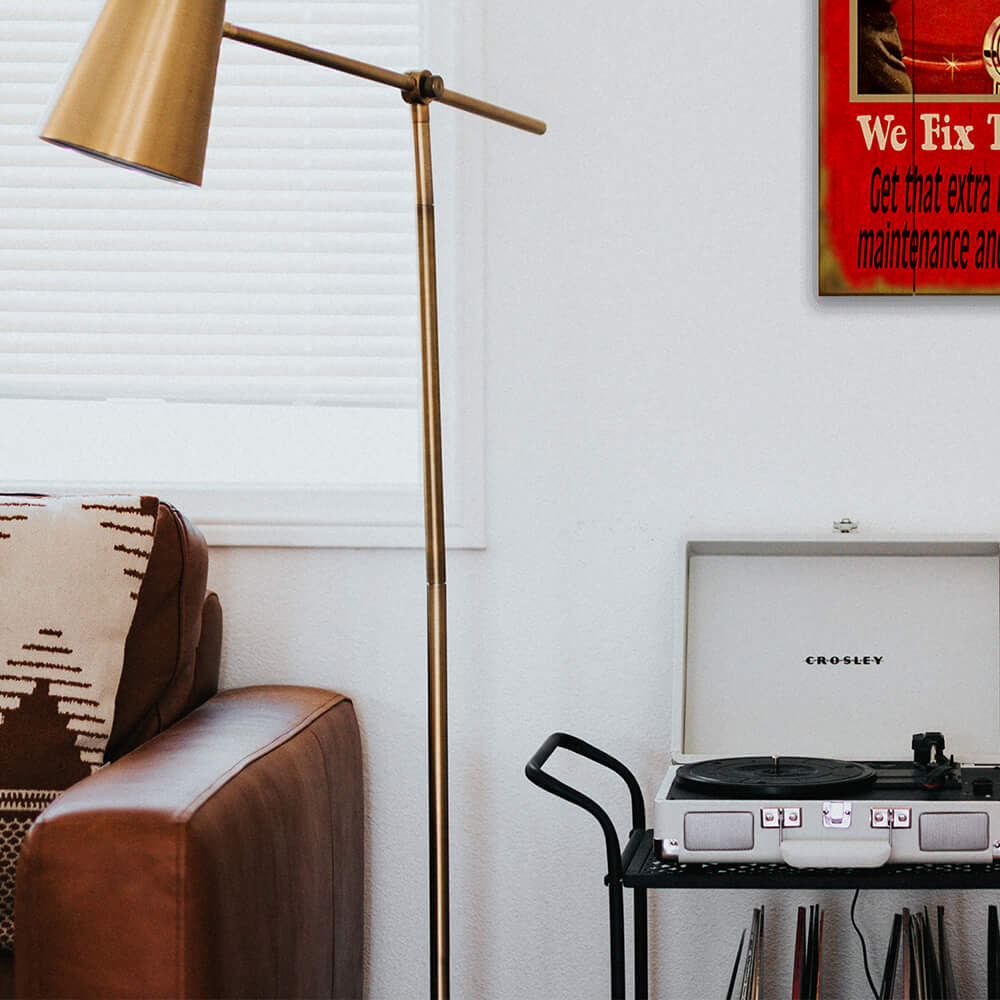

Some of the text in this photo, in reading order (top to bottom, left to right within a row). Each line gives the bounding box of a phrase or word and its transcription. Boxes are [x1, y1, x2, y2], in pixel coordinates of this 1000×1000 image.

[856, 114, 907, 151] We
[920, 113, 975, 151] Fix
[870, 166, 900, 213] Get
[904, 165, 943, 213] that
[947, 165, 992, 213] extra
[857, 222, 970, 269] maintenance
[805, 655, 884, 665] CROSLEY
